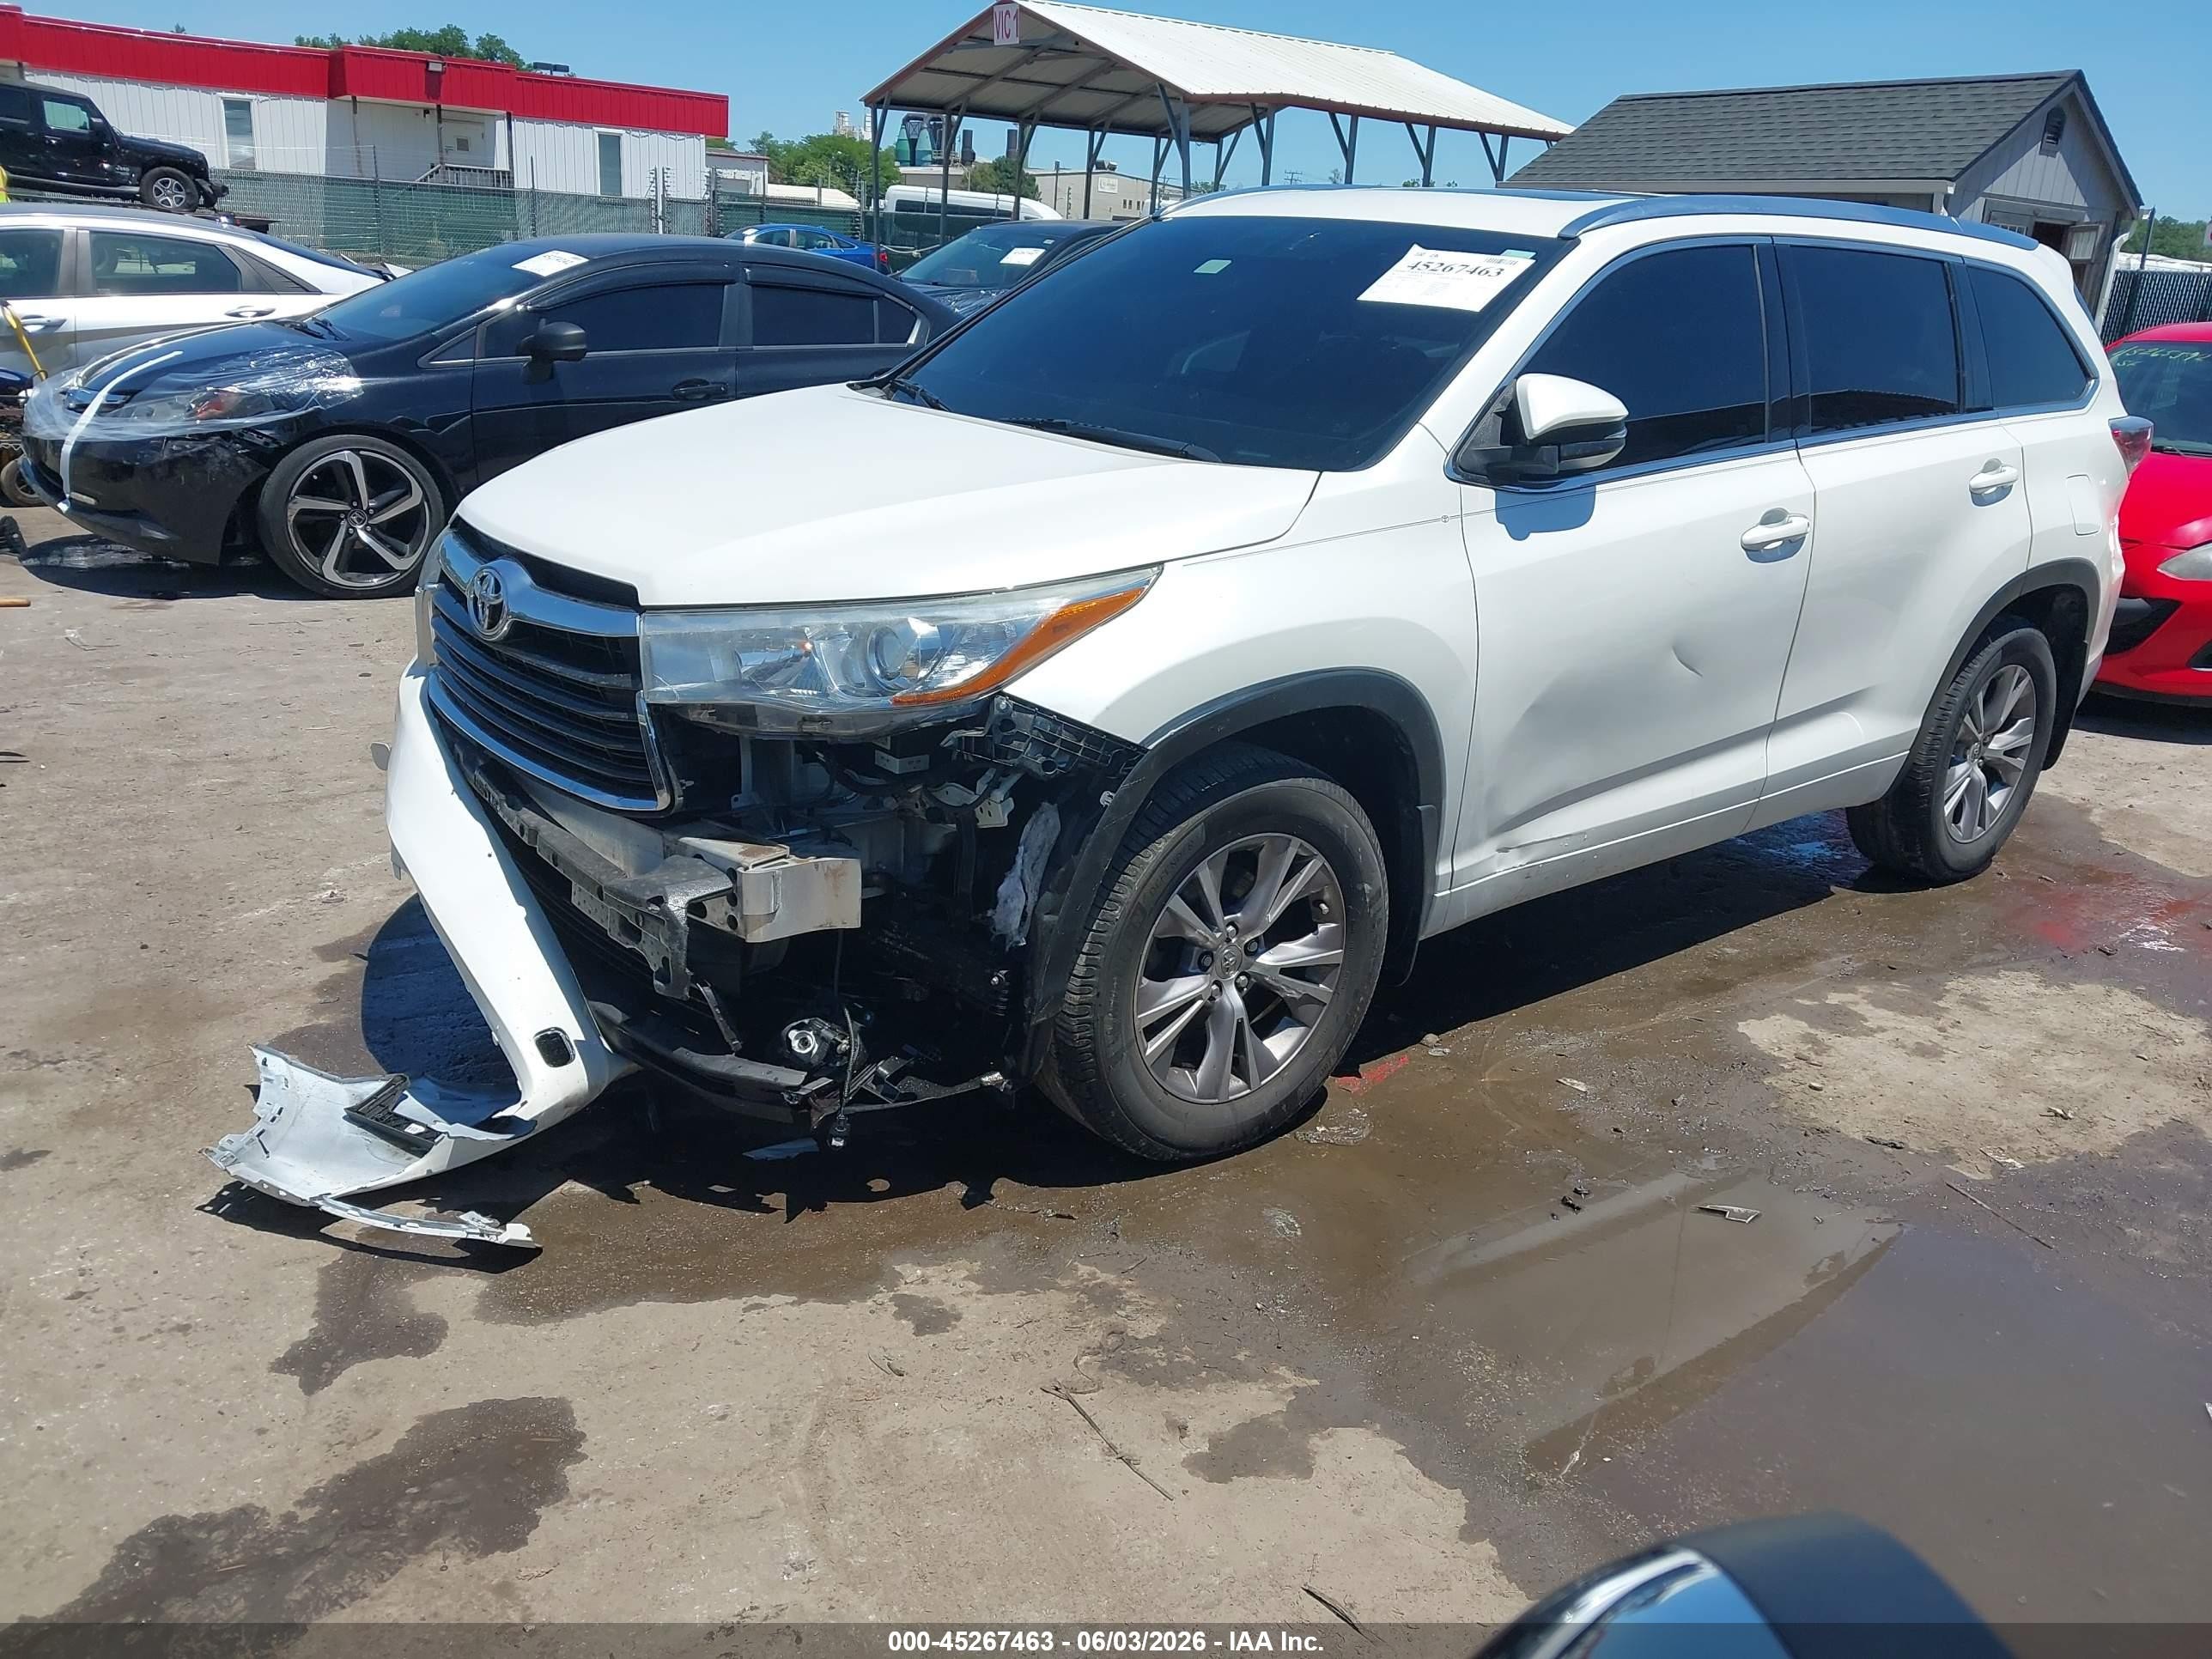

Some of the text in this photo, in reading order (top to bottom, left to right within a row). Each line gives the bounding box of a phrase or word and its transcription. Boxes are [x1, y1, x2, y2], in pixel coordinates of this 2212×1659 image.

[994, 9, 1018, 40] VIC 1
[1407, 260, 1504, 277] 45267463
